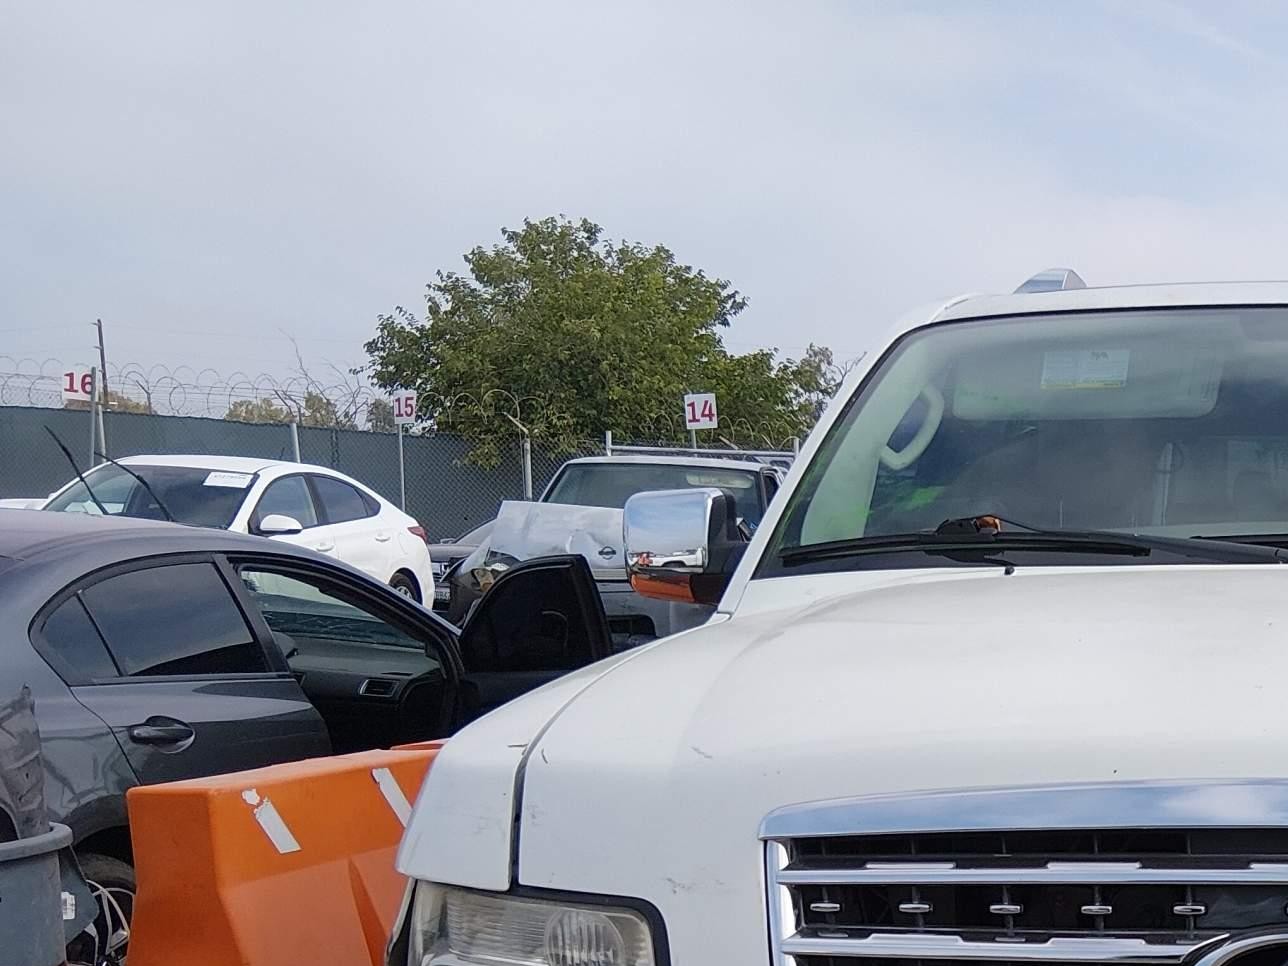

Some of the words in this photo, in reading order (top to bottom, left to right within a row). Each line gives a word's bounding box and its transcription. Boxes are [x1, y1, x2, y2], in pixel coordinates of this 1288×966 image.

[63, 371, 93, 396] 16
[394, 396, 414, 418] 15
[686, 399, 716, 424] 14
